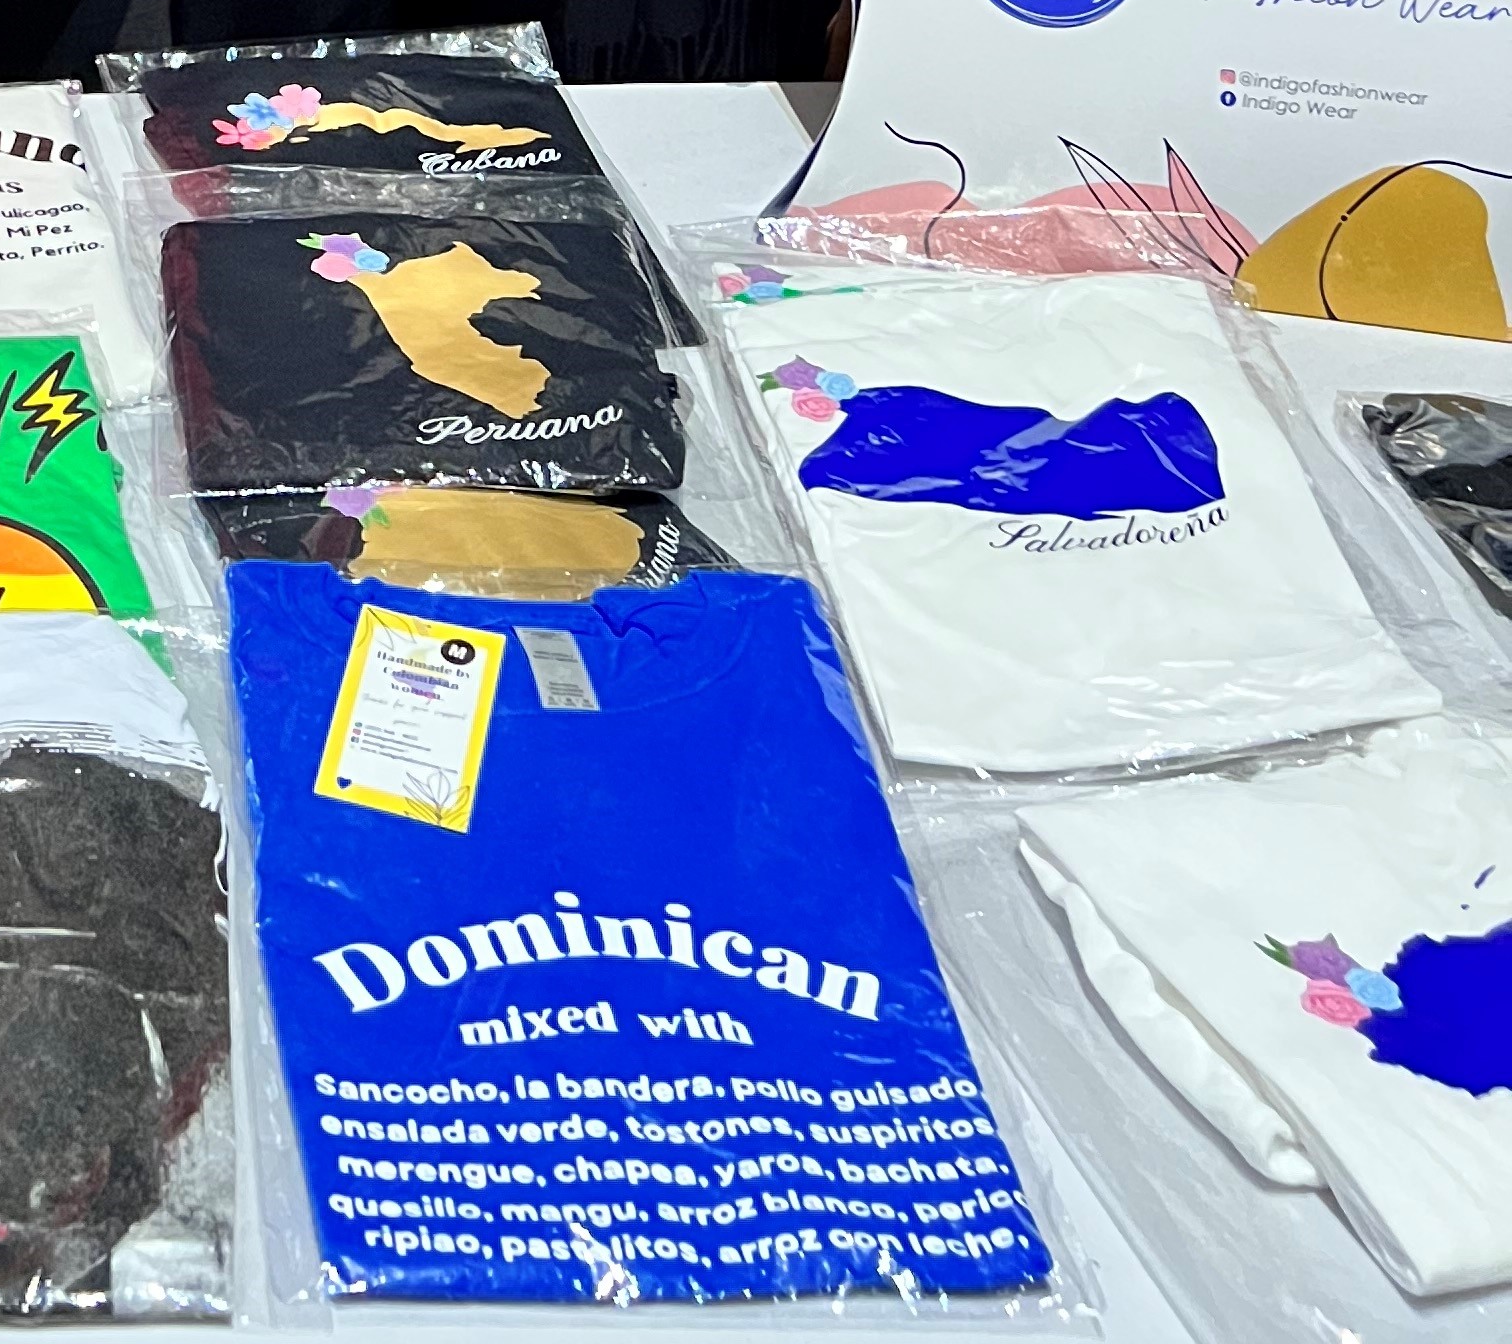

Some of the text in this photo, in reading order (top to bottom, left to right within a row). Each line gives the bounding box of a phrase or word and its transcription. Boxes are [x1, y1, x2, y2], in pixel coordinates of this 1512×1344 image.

[1239, 70, 1428, 106] @indigofashionwear
[1242, 93, 1358, 119] Indigo Wear
[418, 144, 562, 176] Cubana
[6, 226, 32, 239] Mi
[37, 223, 74, 237] Pez
[415, 404, 624, 447] Peruana
[988, 505, 1230, 554] Salvadoreña
[313, 890, 880, 1021] Dominican
[459, 1001, 755, 1049] mixed with
[314, 1073, 510, 1105] Sancocho,
[513, 1075, 551, 1100] la
[555, 1072, 725, 1103] bandera,
[730, 1076, 823, 1107] pollo
[320, 1114, 490, 1144] ensalada
[496, 1113, 620, 1143] verde,
[625, 1115, 805, 1144] tostones,
[338, 1153, 1009, 1189] merengue, chapea, yaroa, bachata,
[328, 1193, 495, 1223] quesillo,
[500, 1200, 649, 1227] mangu,
[657, 1196, 758, 1226] arroz
[761, 1189, 910, 1223] blanco,
[364, 1225, 1029, 1268] ripiao, paslitos, arroz con leche,
